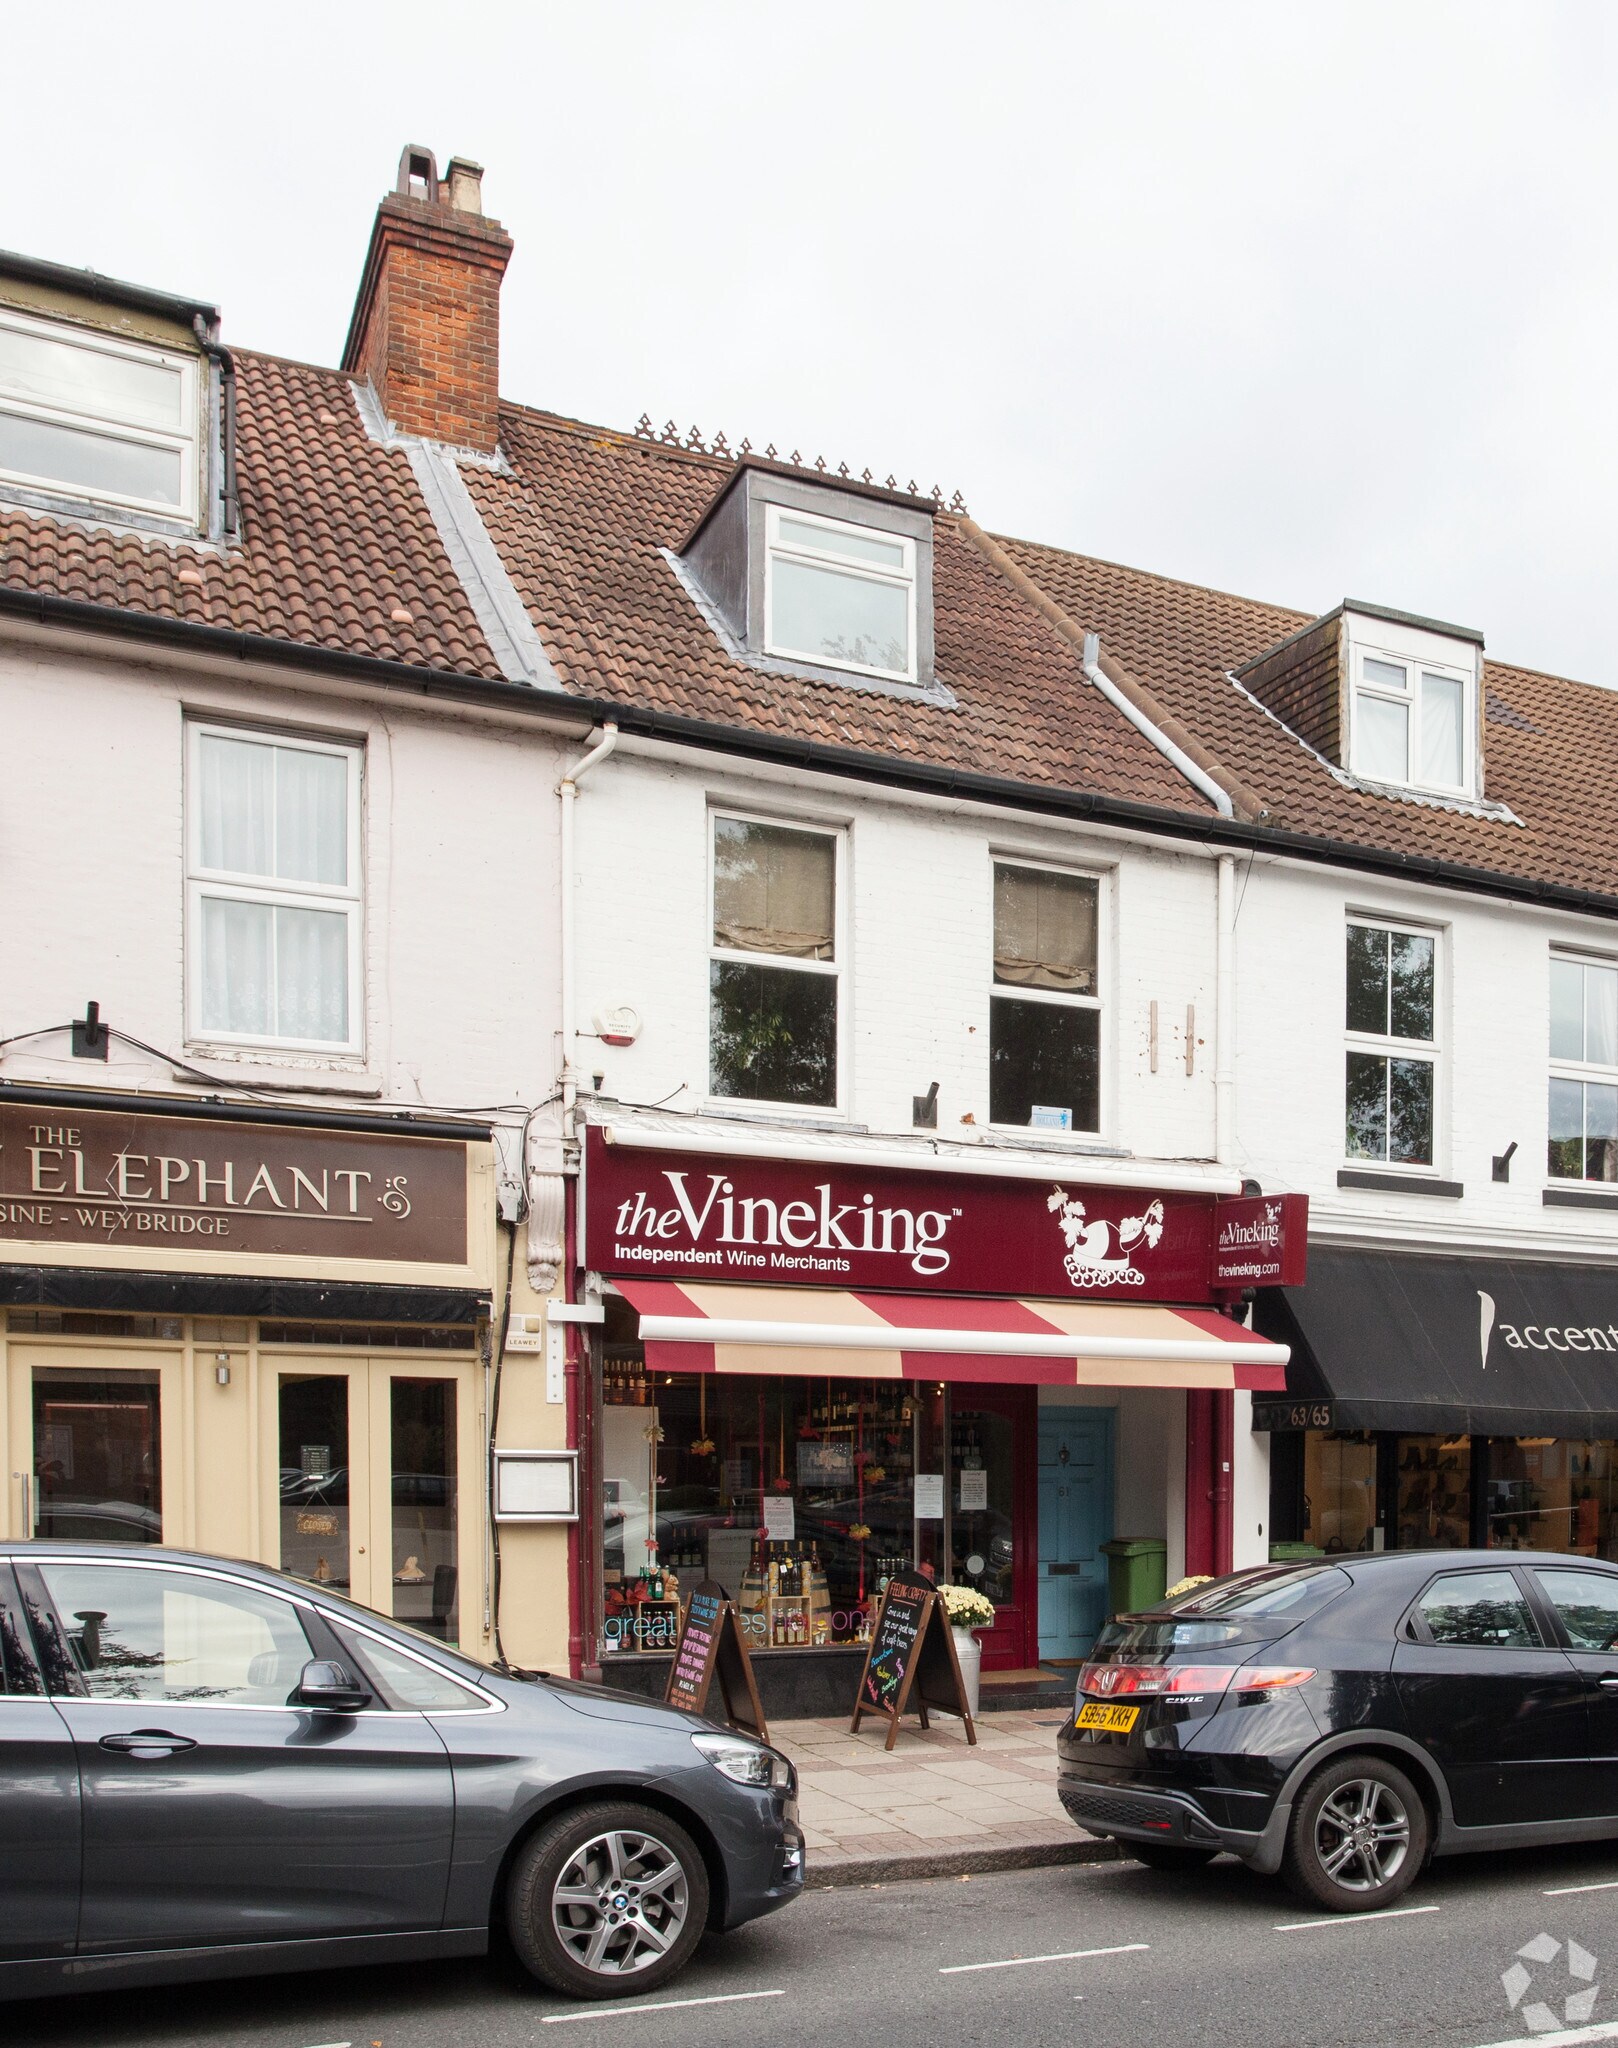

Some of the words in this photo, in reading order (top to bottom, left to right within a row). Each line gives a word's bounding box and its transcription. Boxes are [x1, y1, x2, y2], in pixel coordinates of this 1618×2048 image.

[29, 1125, 82, 1147] THE
[25, 1146, 372, 1213] ELEPHANT
[75, 1208, 230, 1236] WEYBRIDGE
[614, 1243, 723, 1265] Independent
[727, 1249, 766, 1267] Wine
[771, 1253, 850, 1272] Merchants
[1218, 1262, 1280, 1278] thevineking.com
[604, 1610, 678, 1643] great
[1165, 1695, 1204, 1704] CIVIC
[1081, 1705, 1110, 1722] SB56
[1107, 1706, 1135, 1727] XKH
